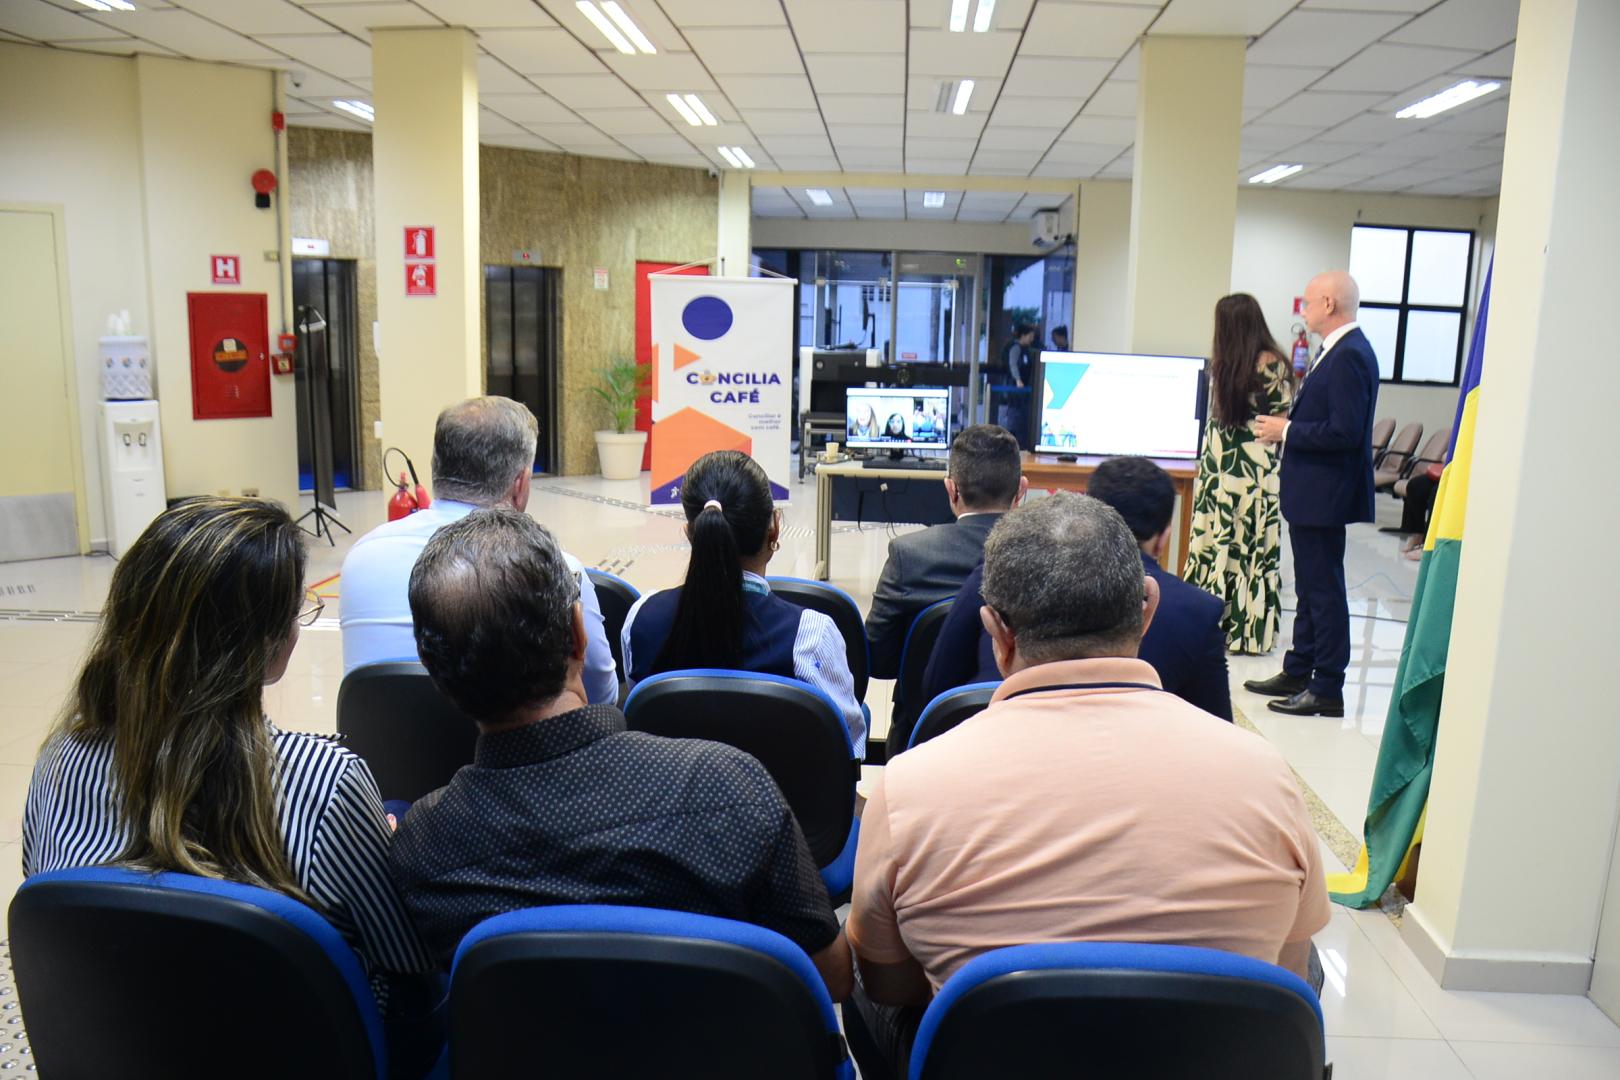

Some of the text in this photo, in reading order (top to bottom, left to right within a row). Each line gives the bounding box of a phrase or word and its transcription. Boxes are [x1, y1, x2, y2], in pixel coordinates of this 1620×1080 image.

[216, 258, 235, 277] H
[686, 372, 781, 385] CONCILIA
[710, 388, 760, 403] CAFÉ
